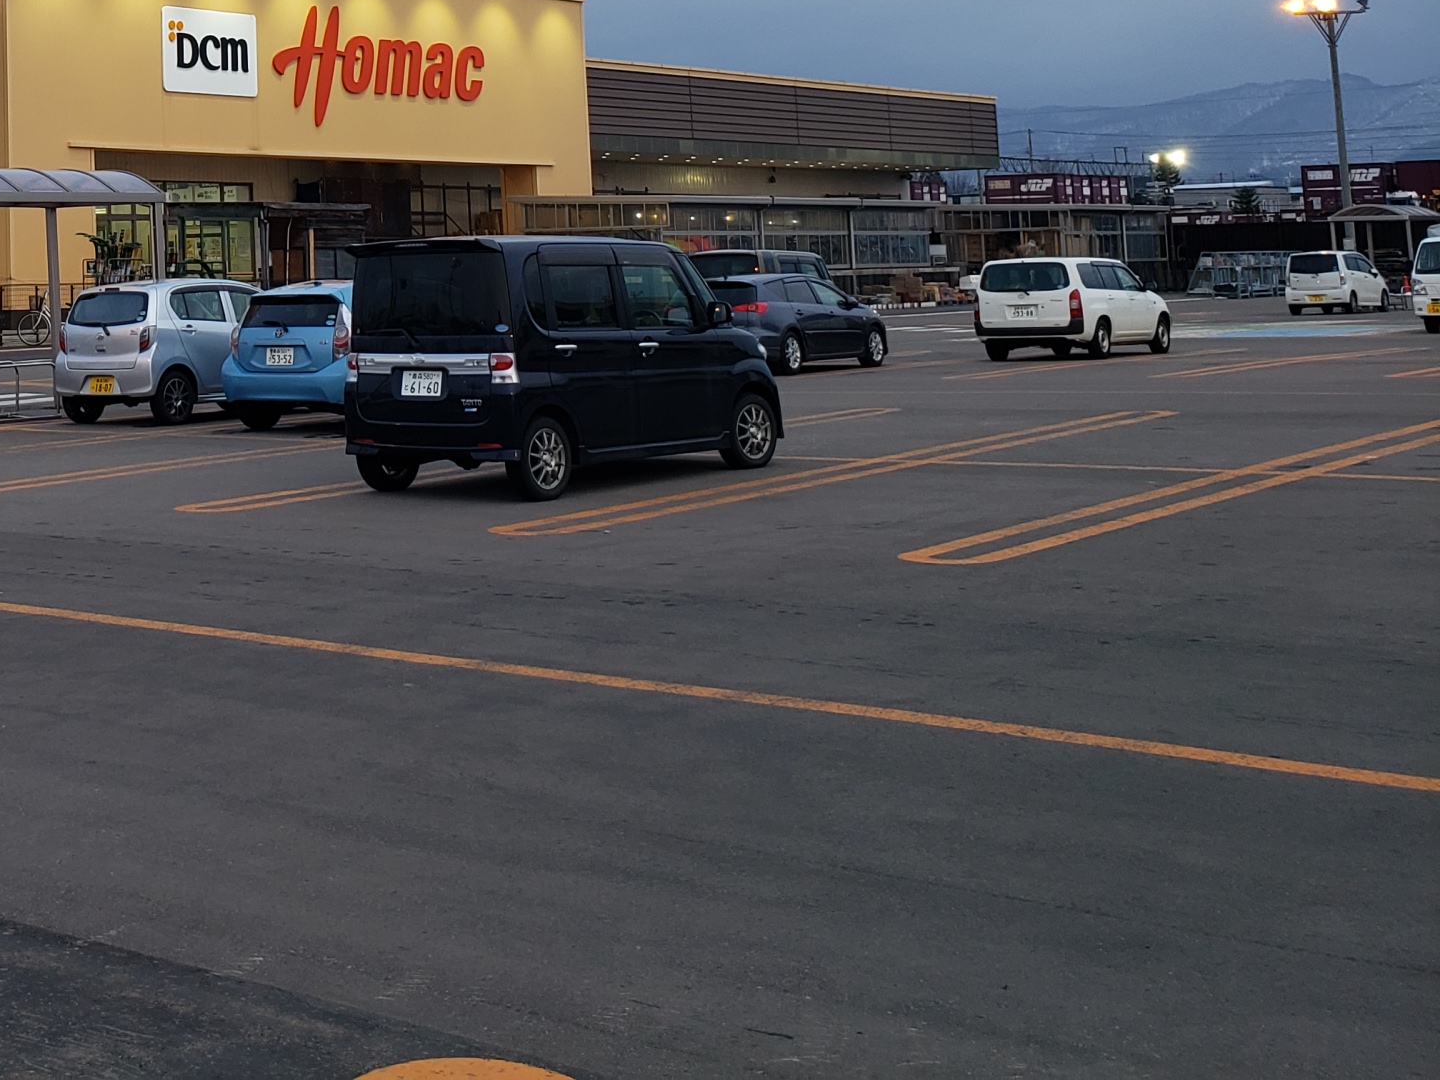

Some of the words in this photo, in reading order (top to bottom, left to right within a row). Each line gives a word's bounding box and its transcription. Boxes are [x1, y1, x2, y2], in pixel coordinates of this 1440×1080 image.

[272, 5, 485, 128] Homac
[1020, 178, 1054, 192] JRF
[271, 354, 292, 364] 53-52
[410, 381, 440, 394] 61-60
[461, 398, 483, 407] TANTO
